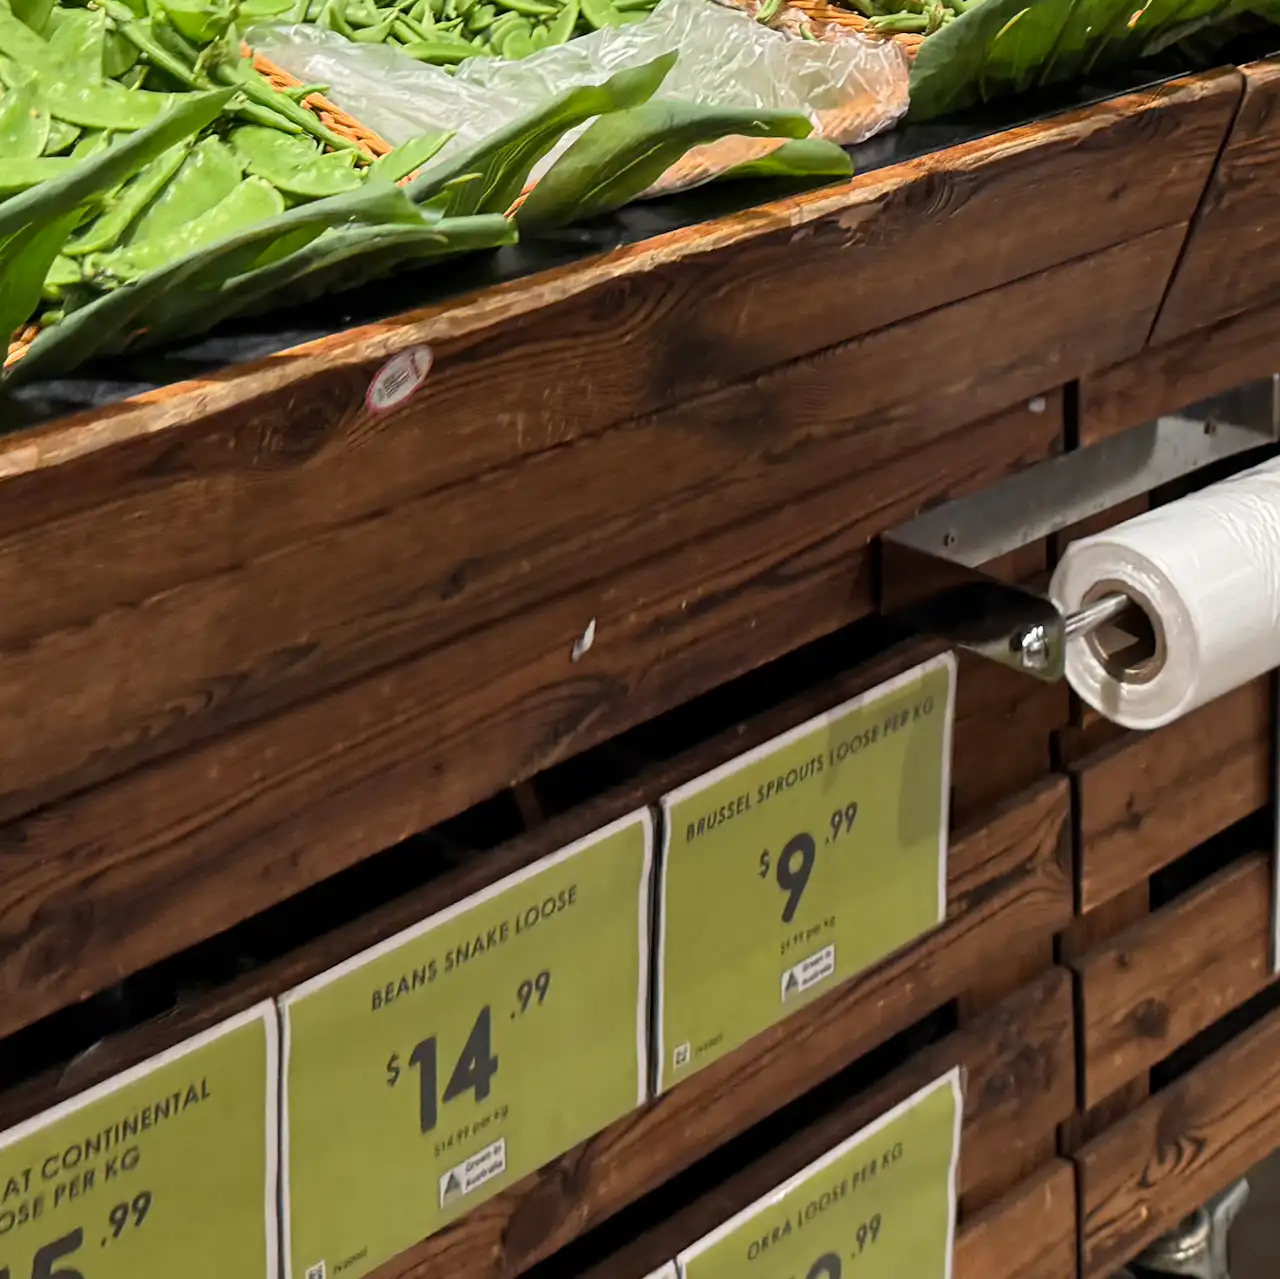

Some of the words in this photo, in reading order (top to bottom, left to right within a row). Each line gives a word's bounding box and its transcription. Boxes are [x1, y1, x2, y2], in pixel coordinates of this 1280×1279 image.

[686, 794, 752, 843] BRUSSEL
[757, 754, 824, 804] SPROUTS
[828, 726, 879, 767] LOOSE
[882, 710, 908, 738] PER
[912, 695, 934, 723] KG
[371, 960, 437, 1012] BEANS
[445, 922, 509, 972] SNAKE
[515, 884, 577, 937] LOOSE
[3, 1168, 32, 1201] AT
[42, 1077, 211, 1180] CONTINENTAL
[54, 1169, 95, 1208] PER
[105, 1146, 141, 1182] KG
[747, 1218, 792, 1260] OKRA
[798, 1179, 848, 1227] LOOSE
[852, 1159, 877, 1191] PER
[881, 1142, 903, 1169] KG
